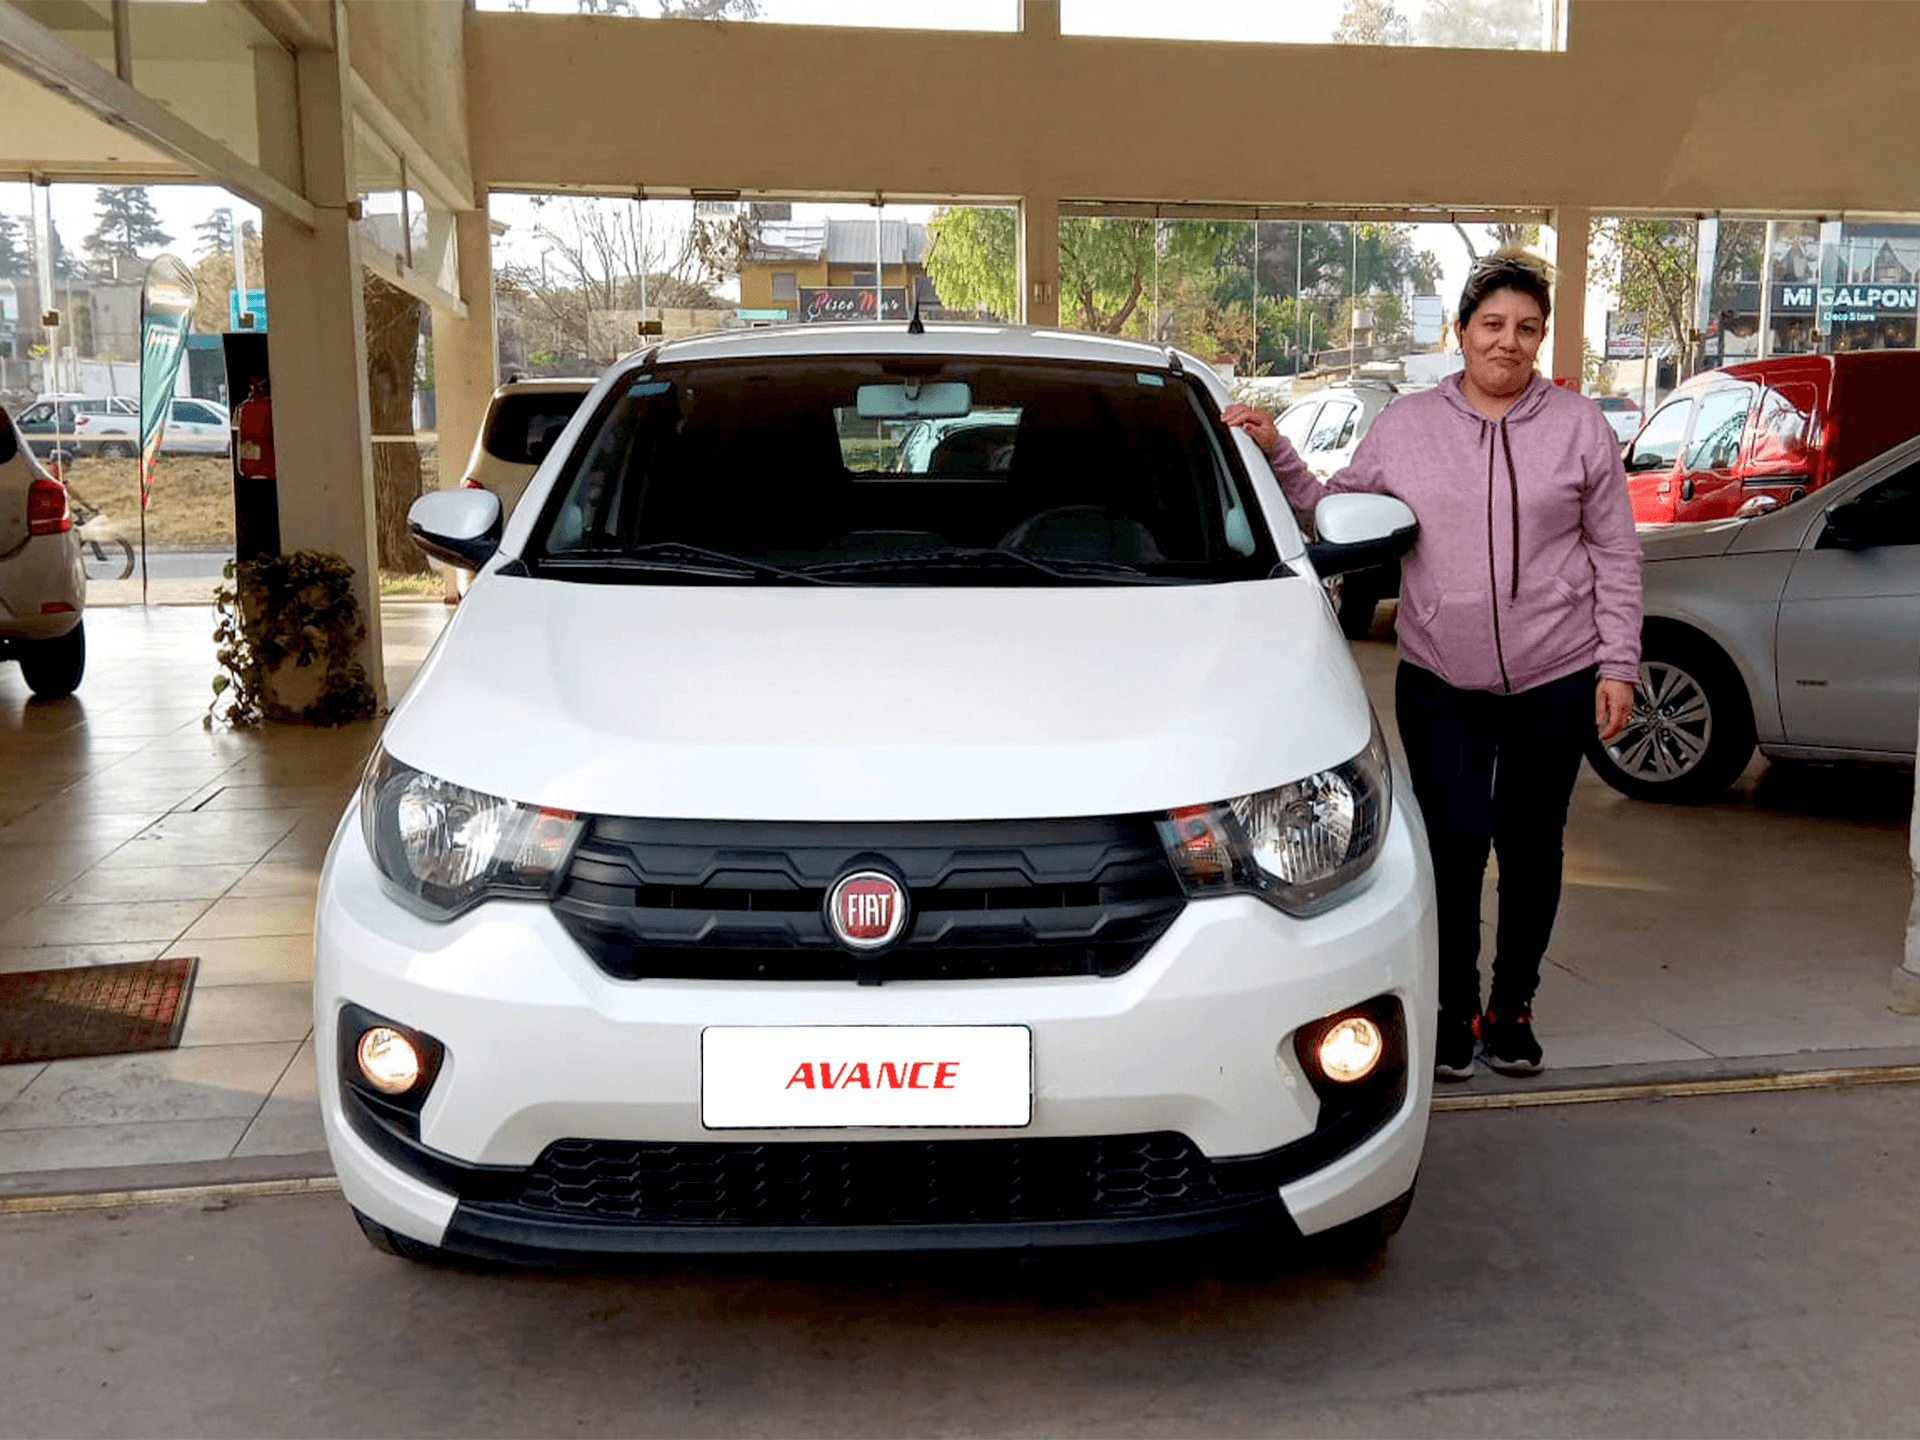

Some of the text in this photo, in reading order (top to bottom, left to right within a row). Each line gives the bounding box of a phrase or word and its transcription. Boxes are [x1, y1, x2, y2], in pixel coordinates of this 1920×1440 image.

[1783, 287, 1917, 307] MI GALPON
[848, 893, 890, 927] FIAT
